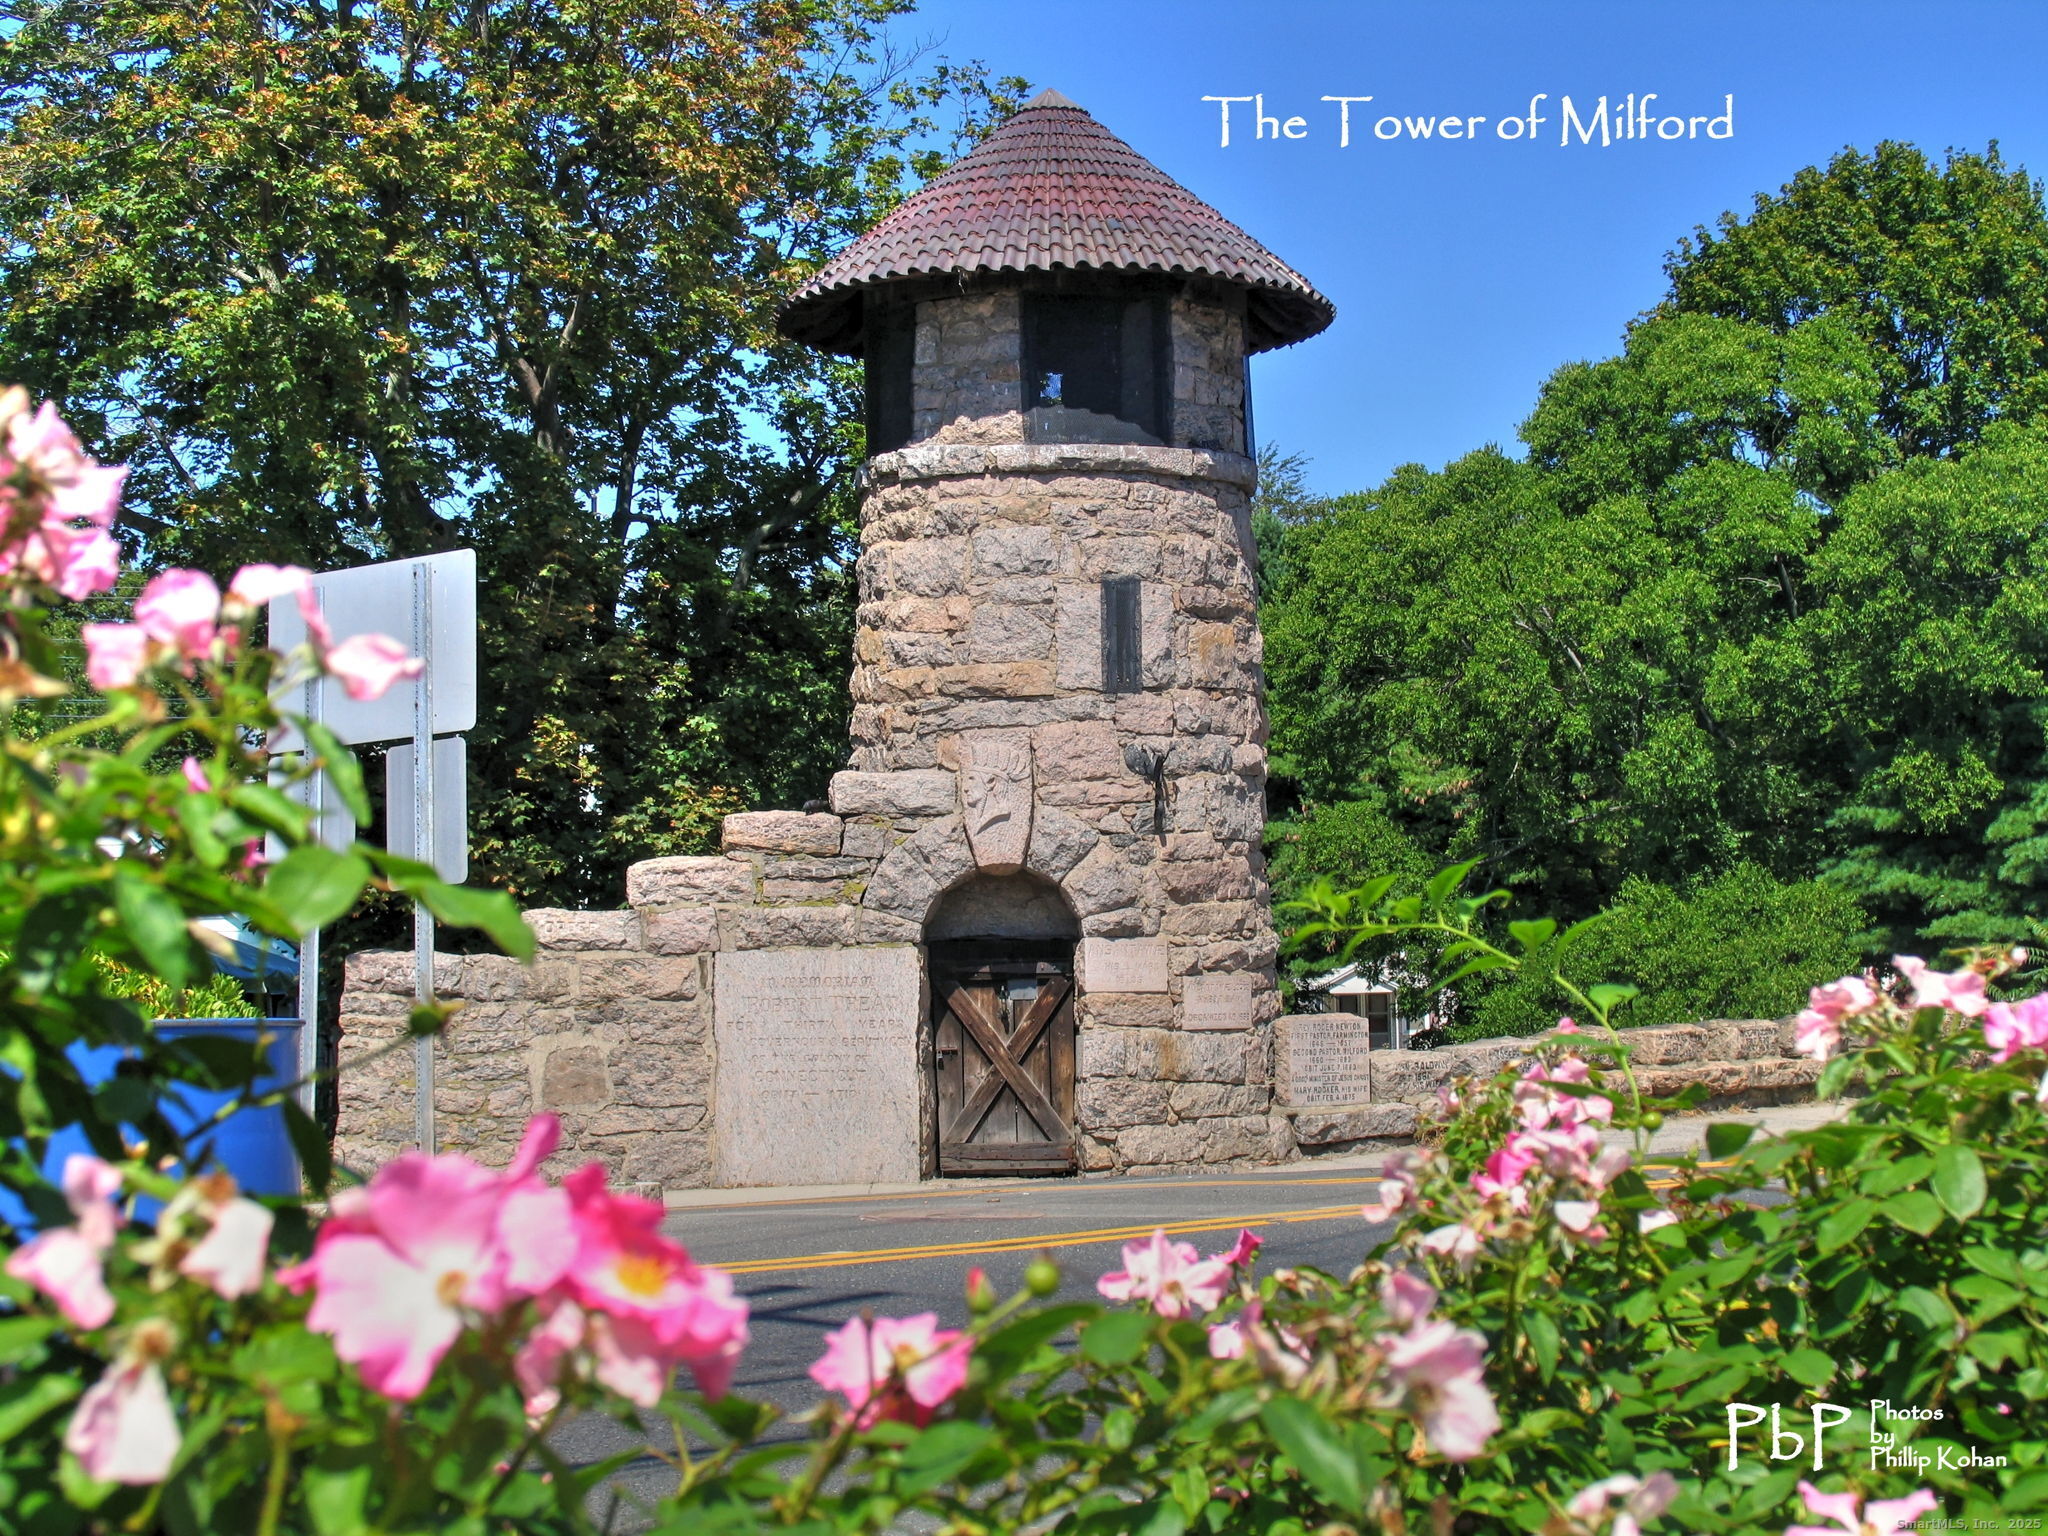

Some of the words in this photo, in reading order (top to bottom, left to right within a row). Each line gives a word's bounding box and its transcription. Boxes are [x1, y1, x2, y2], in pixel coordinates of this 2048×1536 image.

[742, 996, 822, 1012] ROBERT
[828, 994, 898, 1012] TREAT
[726, 1020, 753, 1031] FOR
[858, 1018, 905, 1030] YEARS
[1313, 1022, 1334, 1031] ROGER
[1335, 1022, 1361, 1031] NEWTON
[1290, 1032, 1309, 1040] FIRST
[1332, 1031, 1369, 1039] FARMINGTON
[1292, 1048, 1318, 1057] SECOND
[1342, 1047, 1368, 1056] MILFORD
[1319, 1064, 1335, 1072] JUNE
[1414, 1060, 1448, 1071] BALDWIN
[754, 1069, 867, 1082] CONNECTICUT
[1293, 1086, 1312, 1094] MARY
[1341, 1085, 1351, 1093] HIS
